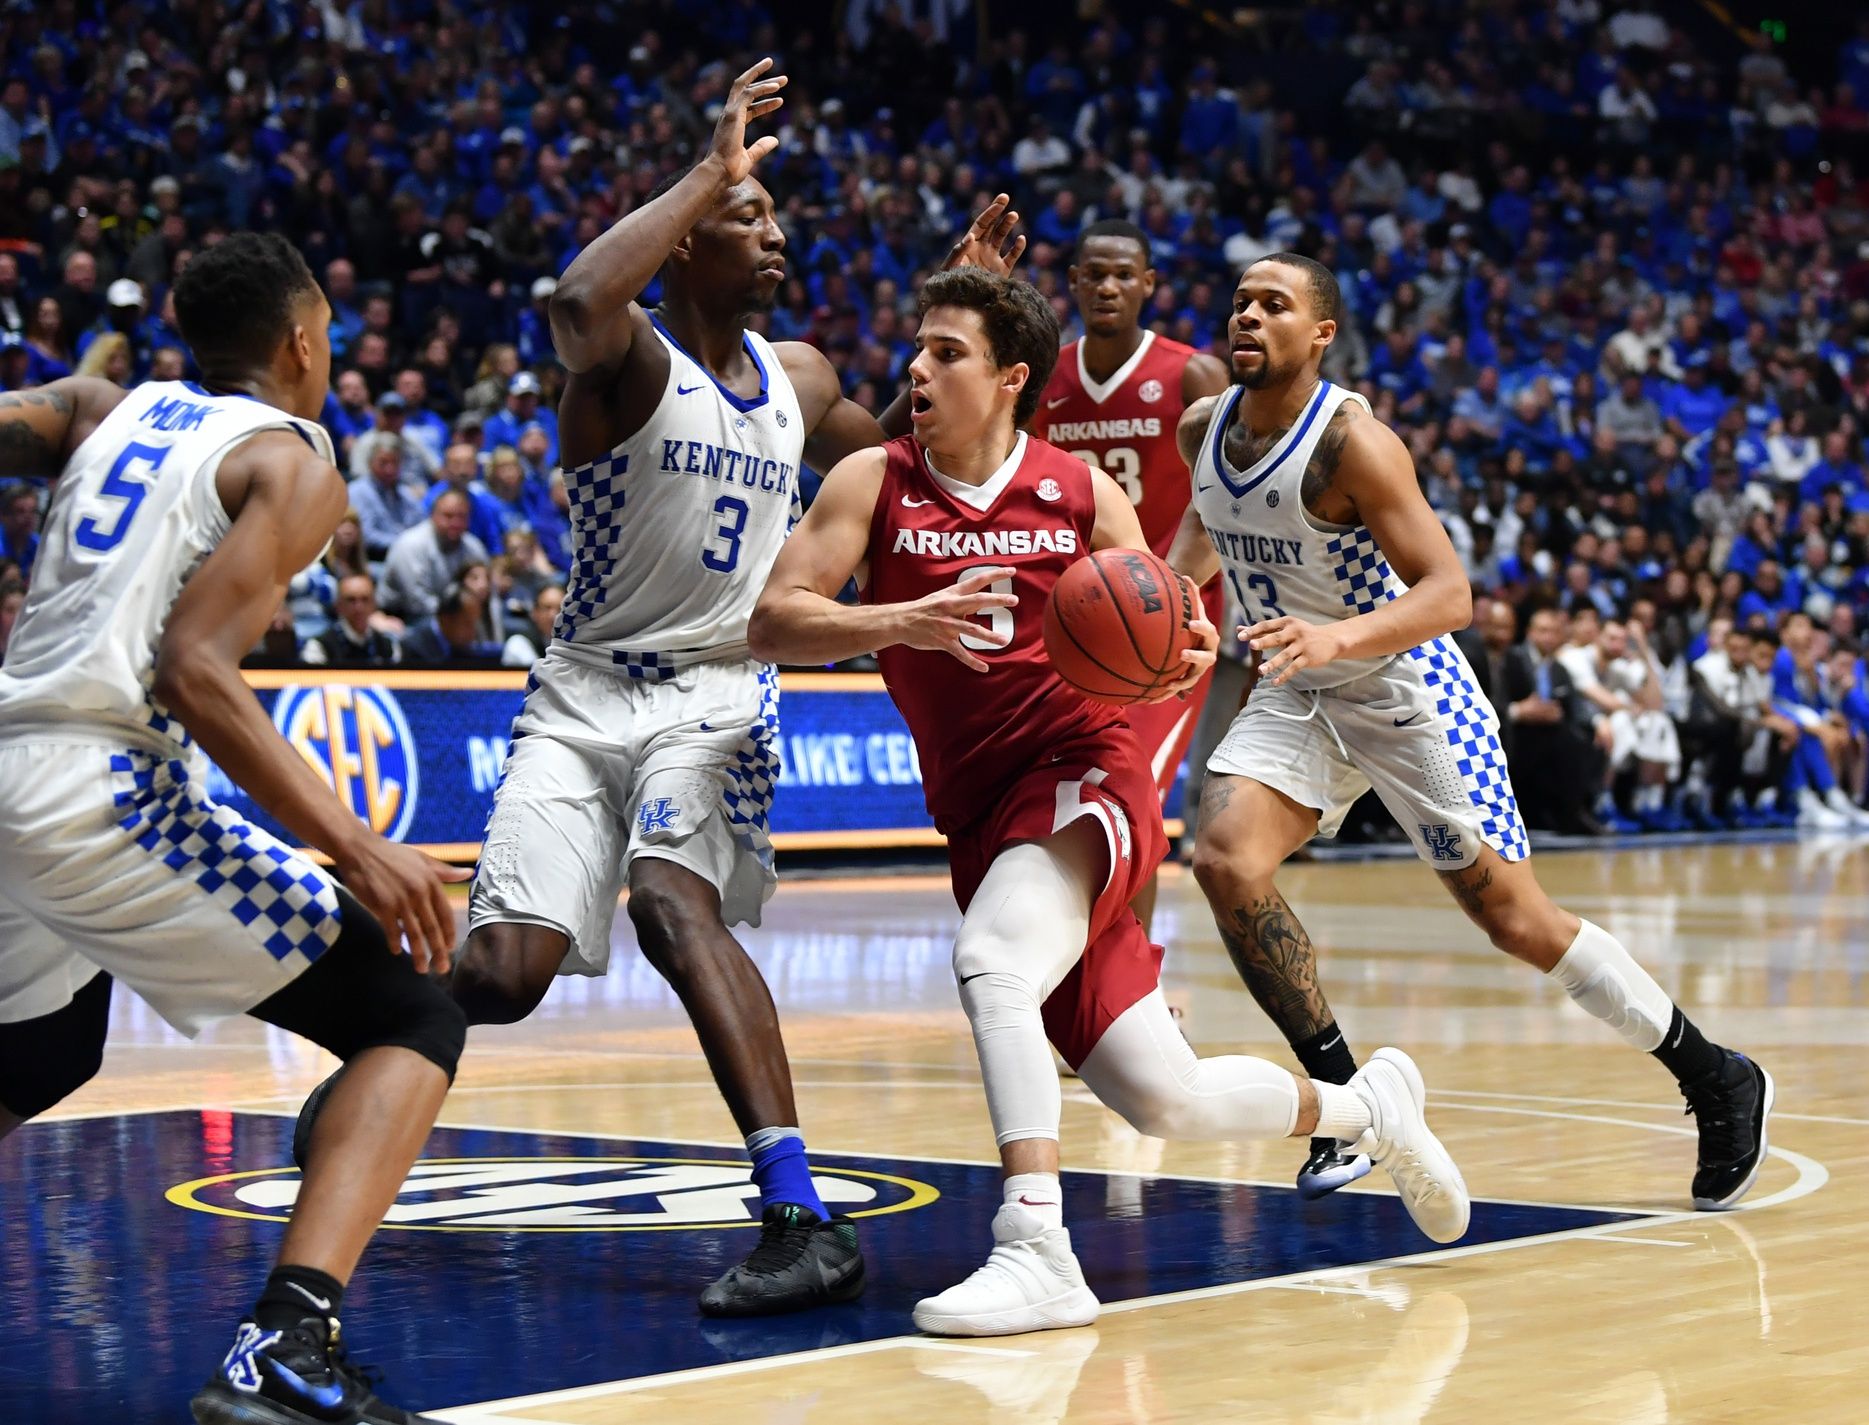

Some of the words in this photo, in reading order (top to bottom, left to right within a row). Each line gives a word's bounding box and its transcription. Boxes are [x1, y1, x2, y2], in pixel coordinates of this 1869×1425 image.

[138, 395, 225, 432] MONK
[1047, 417, 1161, 443] ARKANSAS
[75, 440, 175, 552] 5
[1038, 478, 1060, 496] SEC
[1070, 447, 1143, 507] 3
[701, 494, 749, 574] 3
[892, 527, 1077, 558] ARKANSAS
[1206, 526, 1304, 566] NTUCKY
[956, 565, 1015, 651] 3
[1119, 554, 1164, 615] NCAA
[1227, 568, 1288, 626] 13
[770, 733, 865, 788] LIKE
[1418, 823, 1464, 861] UK
